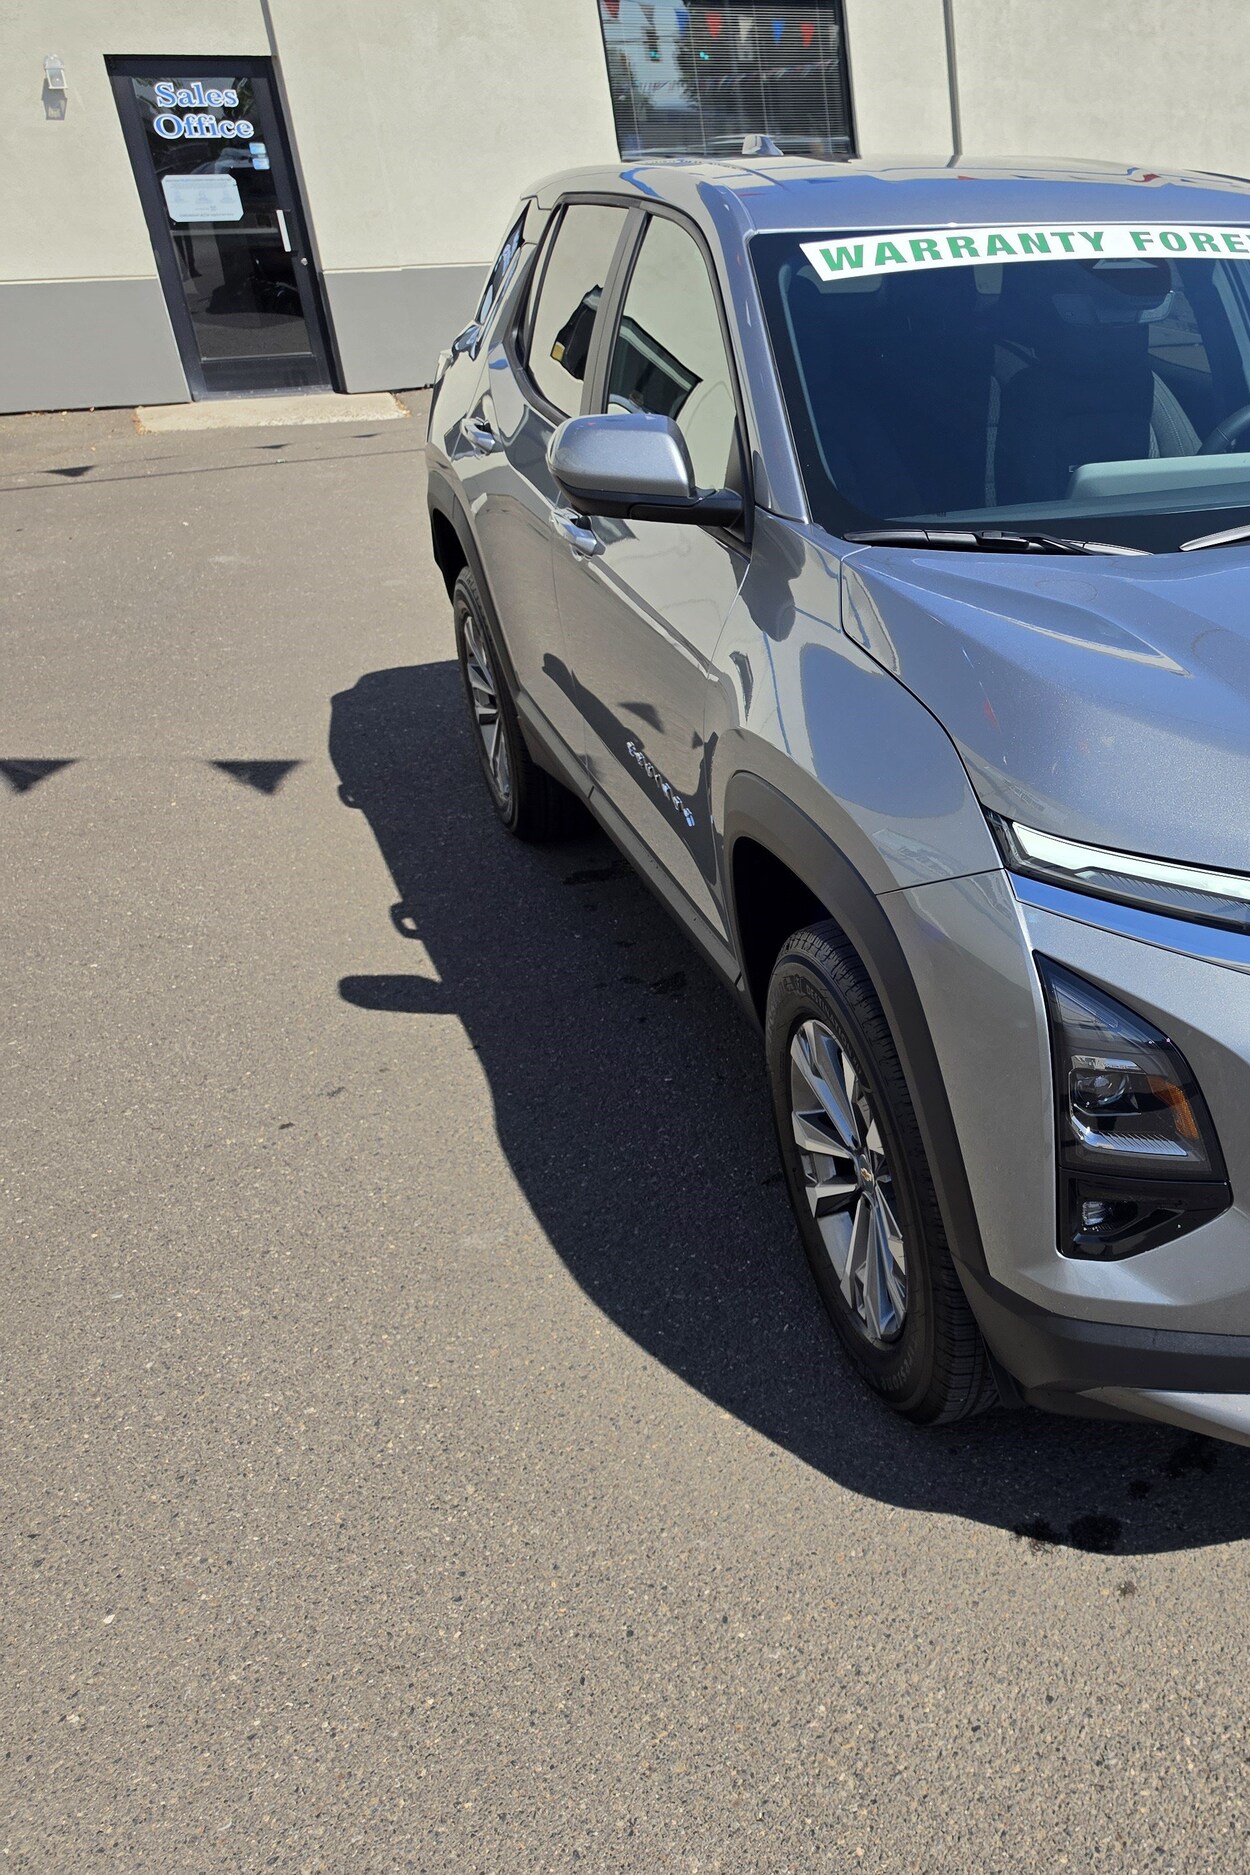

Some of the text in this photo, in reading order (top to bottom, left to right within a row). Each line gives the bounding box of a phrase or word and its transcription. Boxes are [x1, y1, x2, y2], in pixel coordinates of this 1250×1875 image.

[154, 82, 240, 108] Sales
[153, 113, 255, 139] Office
[818, 231, 1104, 272] WARRANTY
